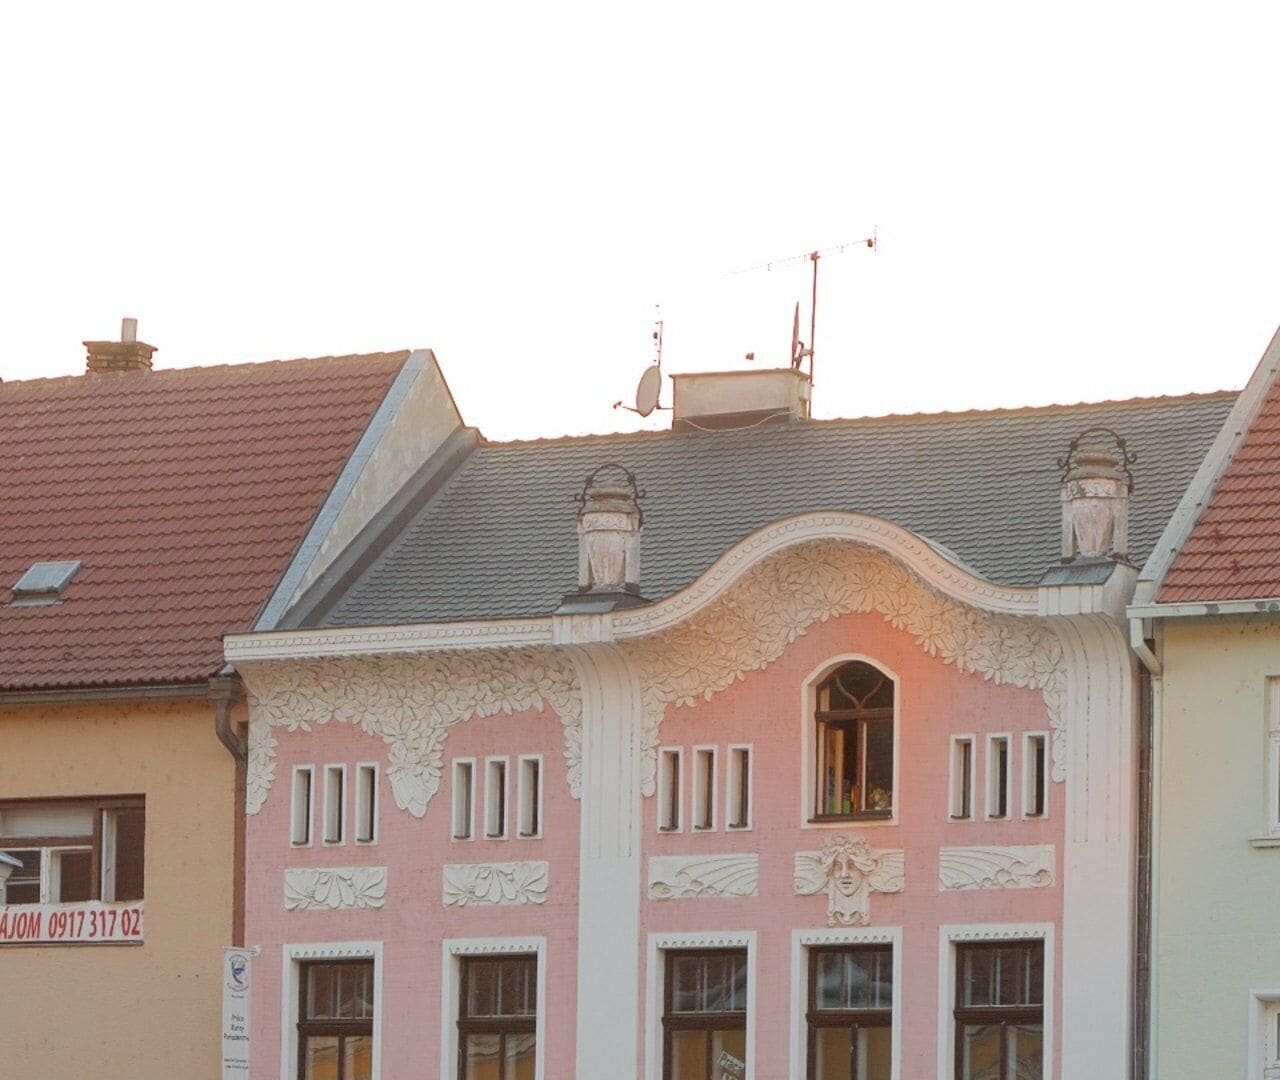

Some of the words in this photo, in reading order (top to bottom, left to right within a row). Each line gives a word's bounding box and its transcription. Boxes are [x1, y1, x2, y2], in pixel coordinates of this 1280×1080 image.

[48, 910, 86, 939] 0917
[88, 908, 118, 938] 317
[121, 907, 145, 937] 02
